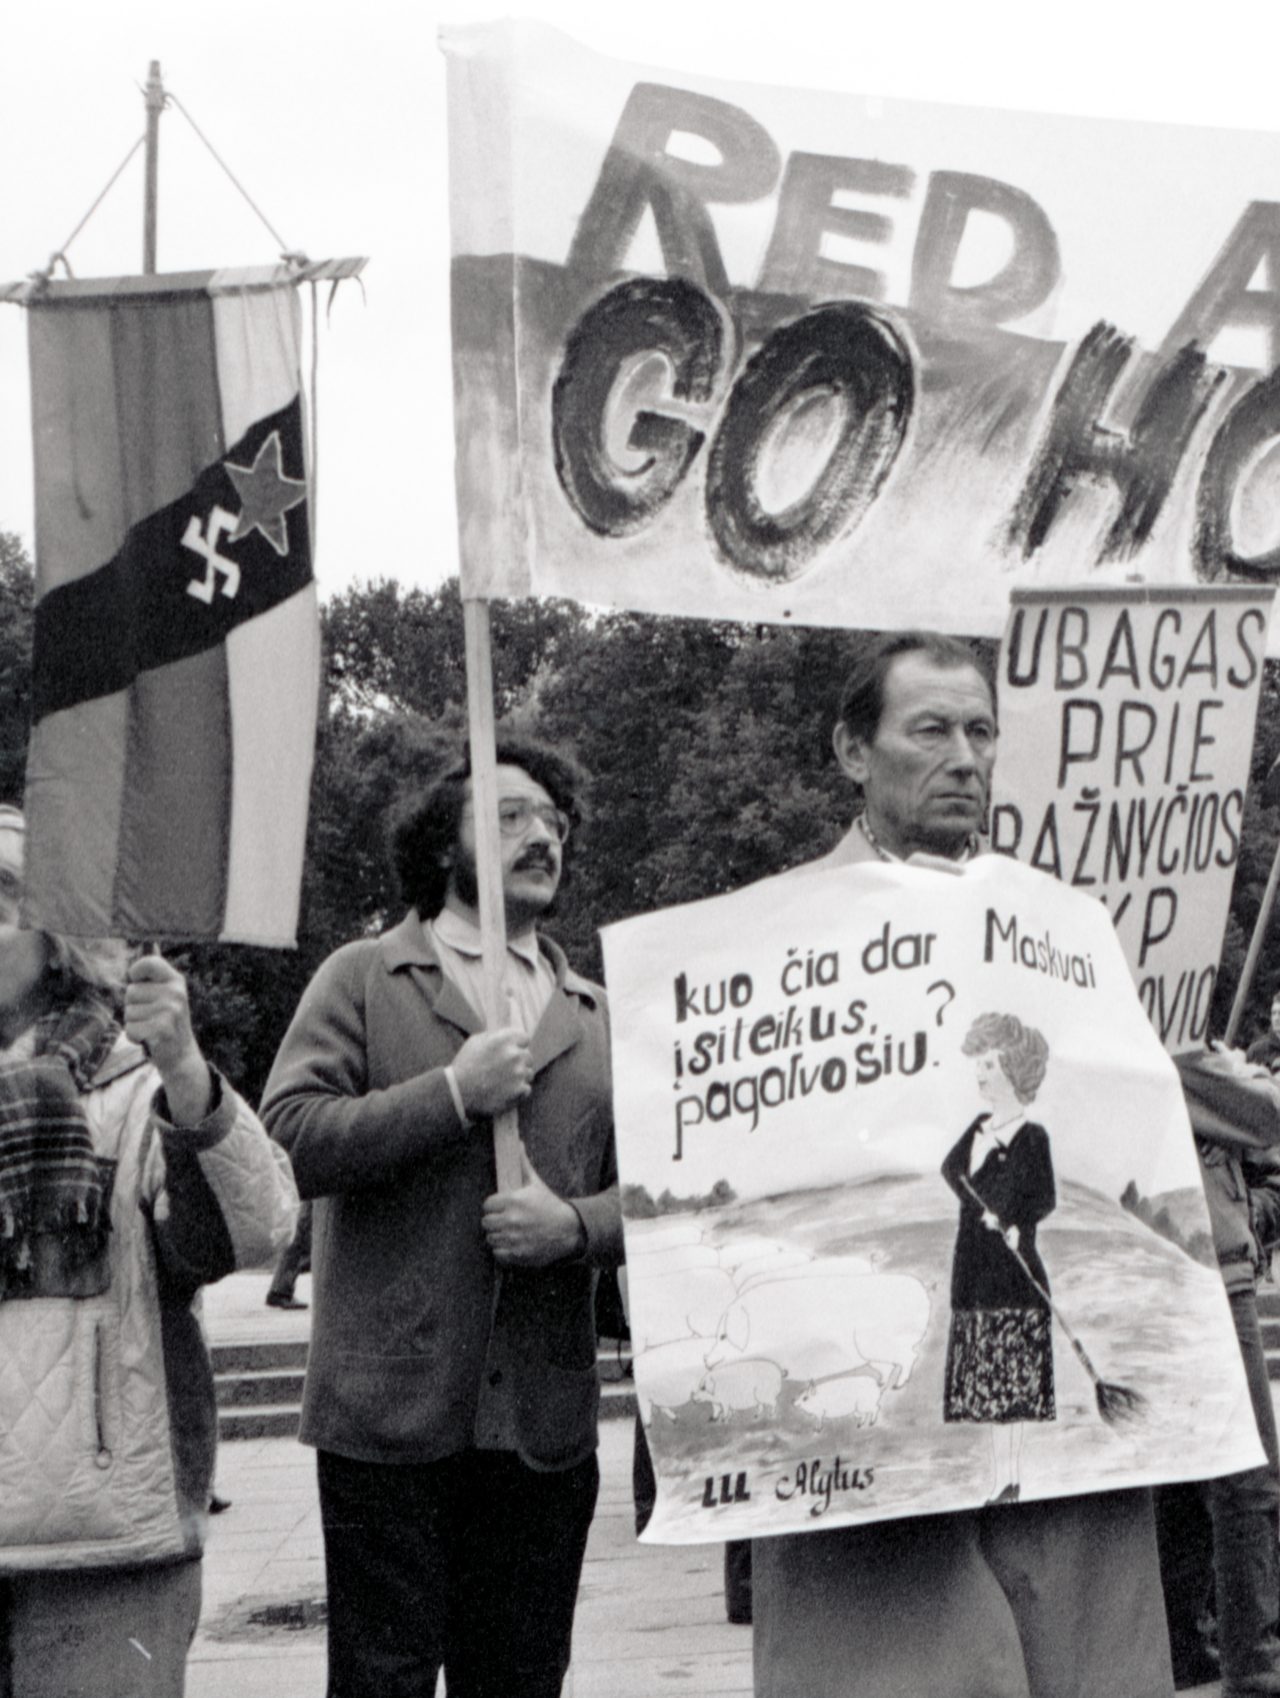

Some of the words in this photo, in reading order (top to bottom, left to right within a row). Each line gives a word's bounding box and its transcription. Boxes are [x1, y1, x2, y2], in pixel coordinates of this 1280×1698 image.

[565, 81, 1062, 324] RED
[551, 276, 917, 587] GO
[1006, 606, 1266, 691] UBAGAS
[1058, 699, 1225, 789] PRIE
[673, 970, 753, 1024] kuo
[780, 946, 839, 997] čia
[861, 921, 937, 975] dar
[983, 906, 1097, 990] Maskvai
[774, 1453, 876, 1518] Alytus
